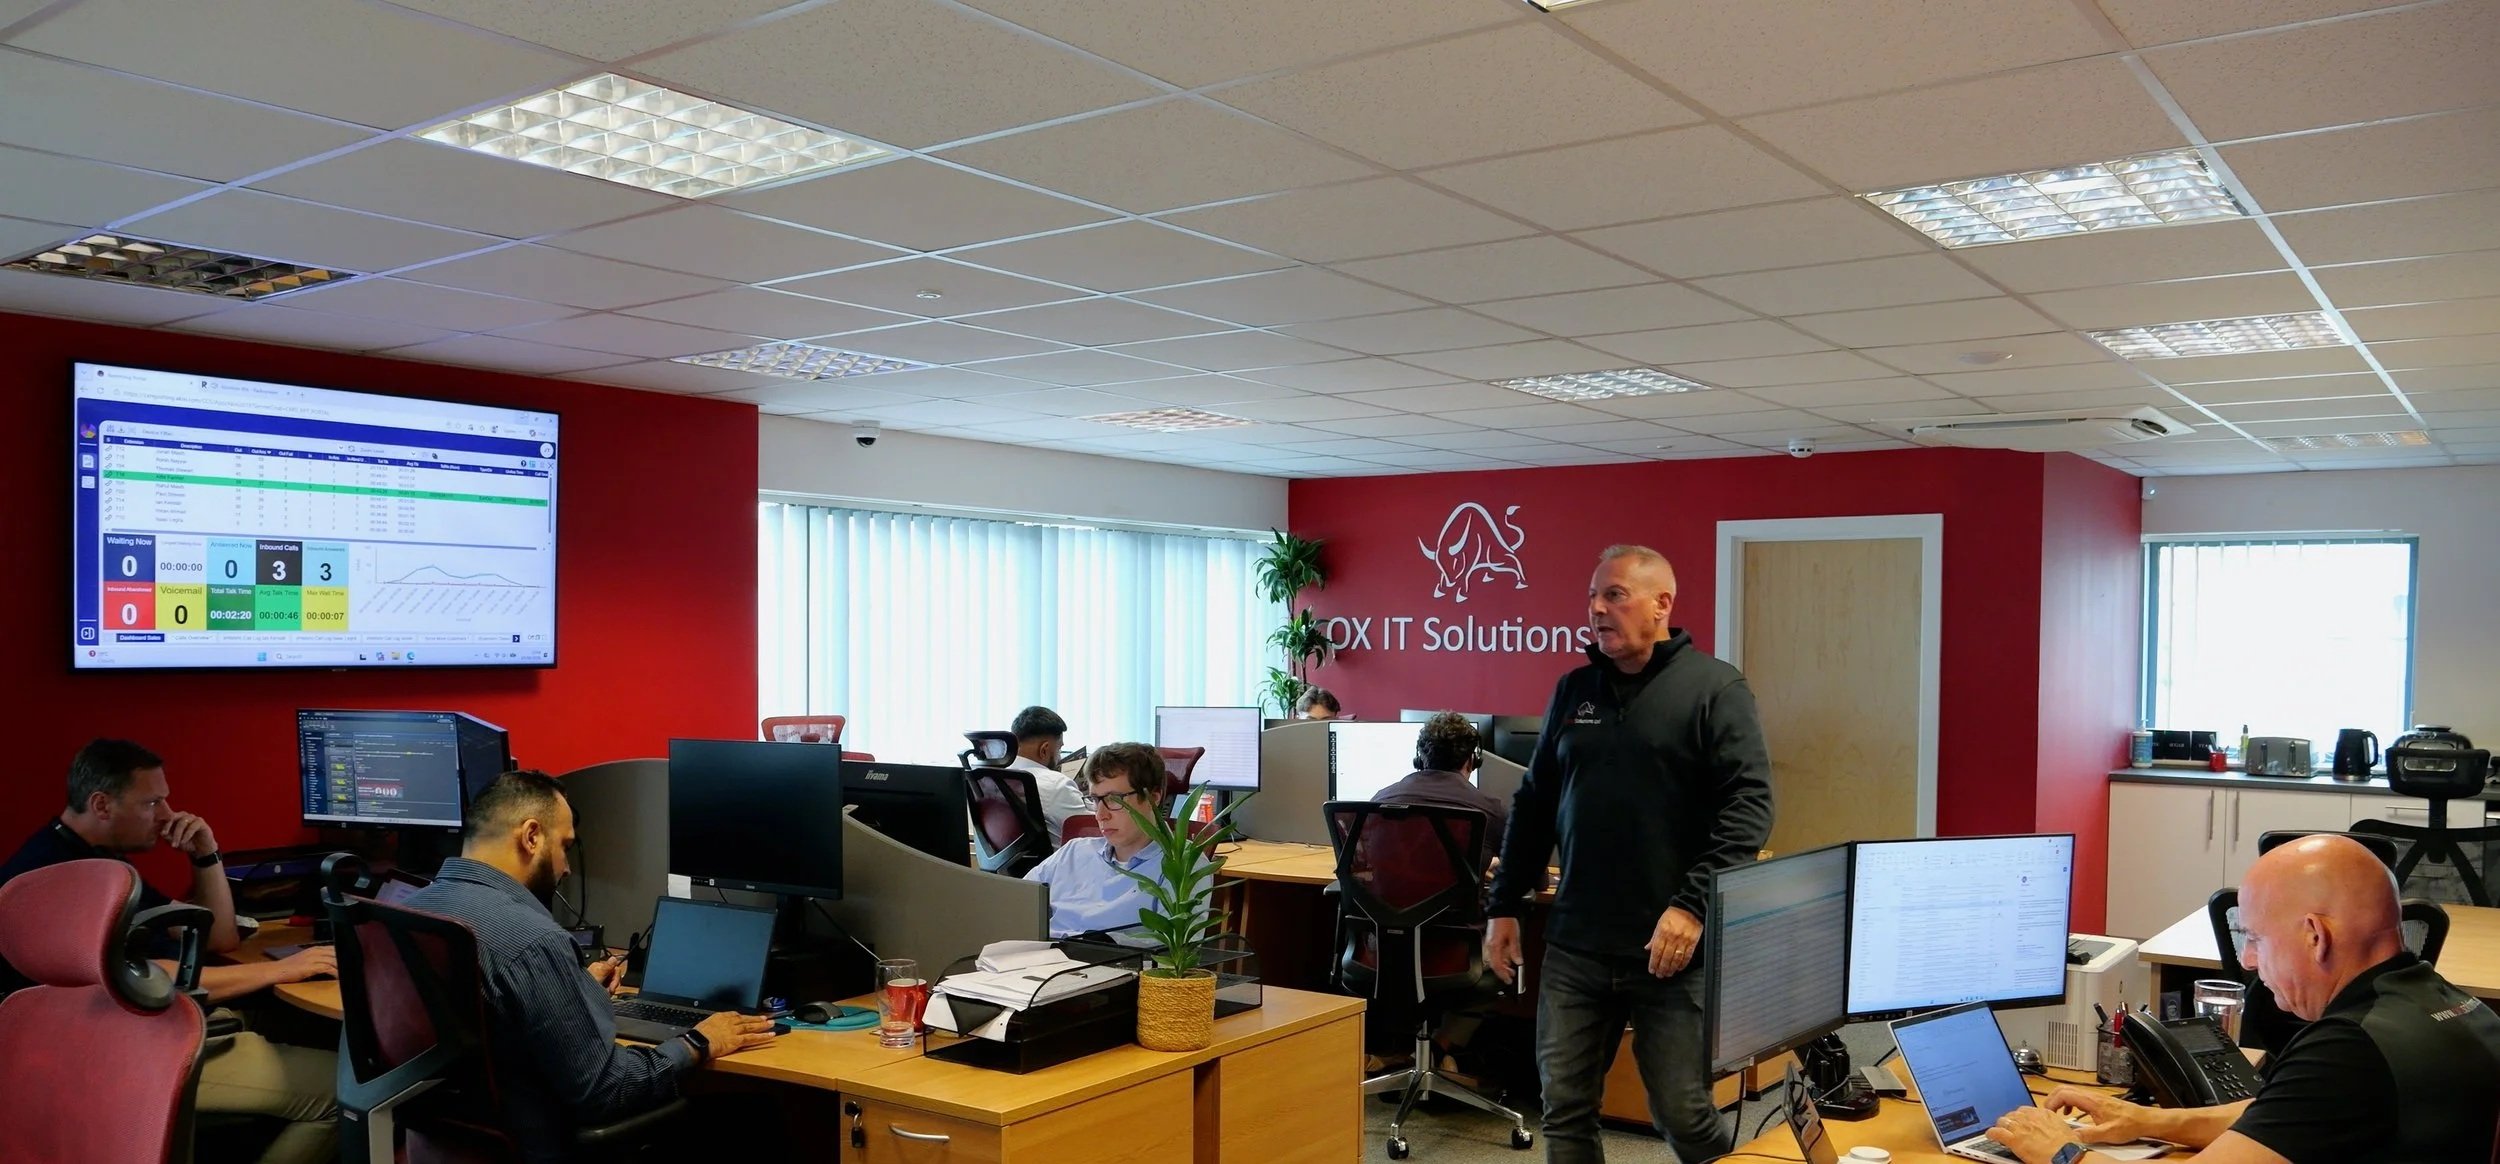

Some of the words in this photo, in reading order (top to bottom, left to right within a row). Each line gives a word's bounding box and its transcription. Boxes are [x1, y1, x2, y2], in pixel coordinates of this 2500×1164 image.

[107, 537, 134, 546] Waiting
[136, 538, 152, 546] Now
[122, 555, 137, 577] 0
[160, 562, 203, 571] 00:00:00
[225, 560, 238, 578] 0
[272, 560, 287, 581] 3
[320, 563, 332, 581] 3
[160, 586, 203, 595] Voicemail
[122, 603, 137, 625] 0
[175, 604, 188, 625] 0
[210, 611, 252, 620] 00:02:20
[259, 611, 299, 620] 00:00:46
[306, 612, 345, 620] 00:00:07
[1326, 617, 1372, 650] OX
[1384, 617, 1413, 650] IT
[1423, 615, 1591, 653] Solutions
